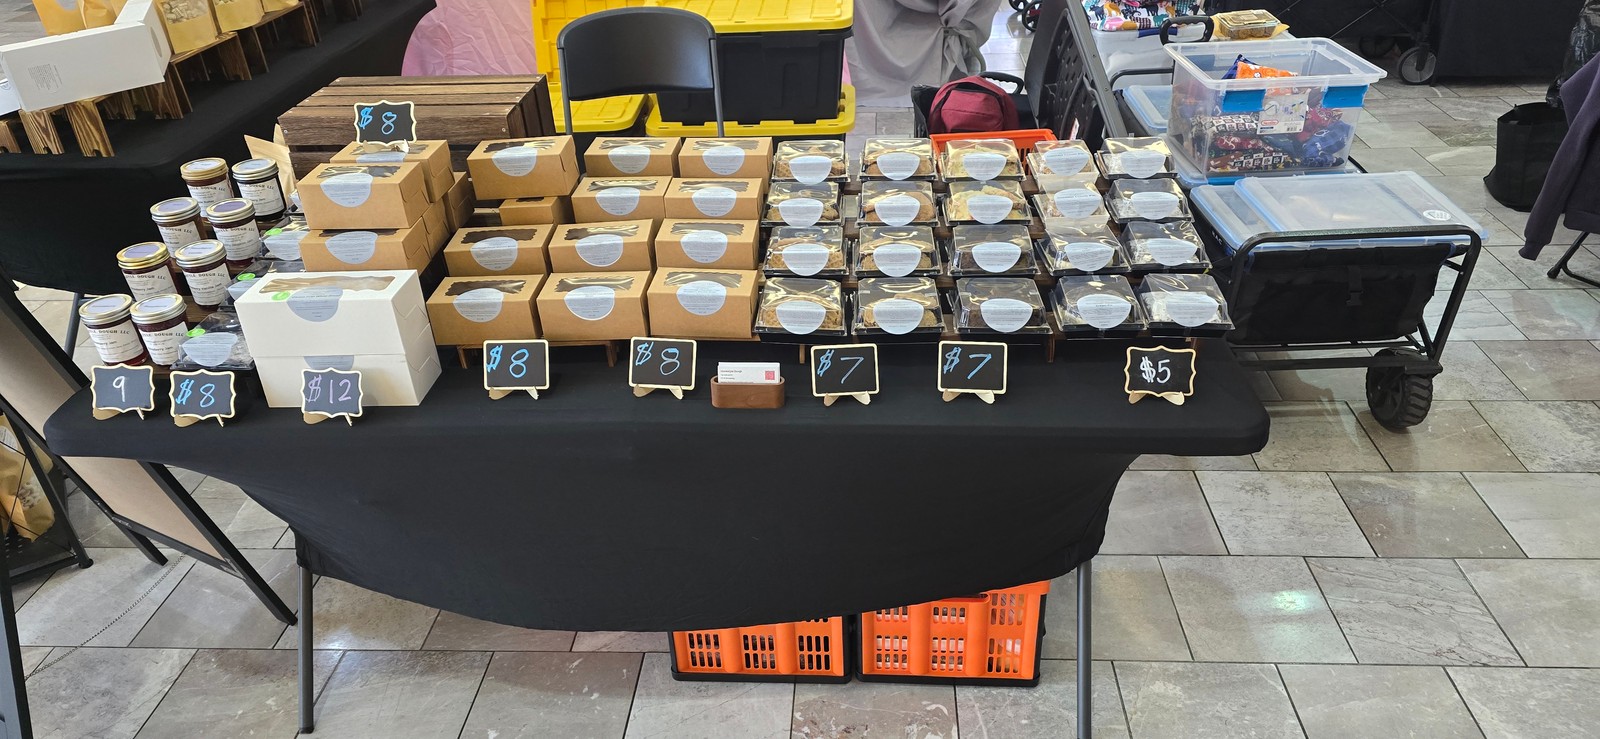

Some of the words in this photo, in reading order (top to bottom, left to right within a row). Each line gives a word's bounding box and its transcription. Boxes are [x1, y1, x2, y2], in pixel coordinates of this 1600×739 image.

[1140, 356, 1171, 384] $5
[112, 375, 126, 402] 9
[305, 374, 351, 404] $12
